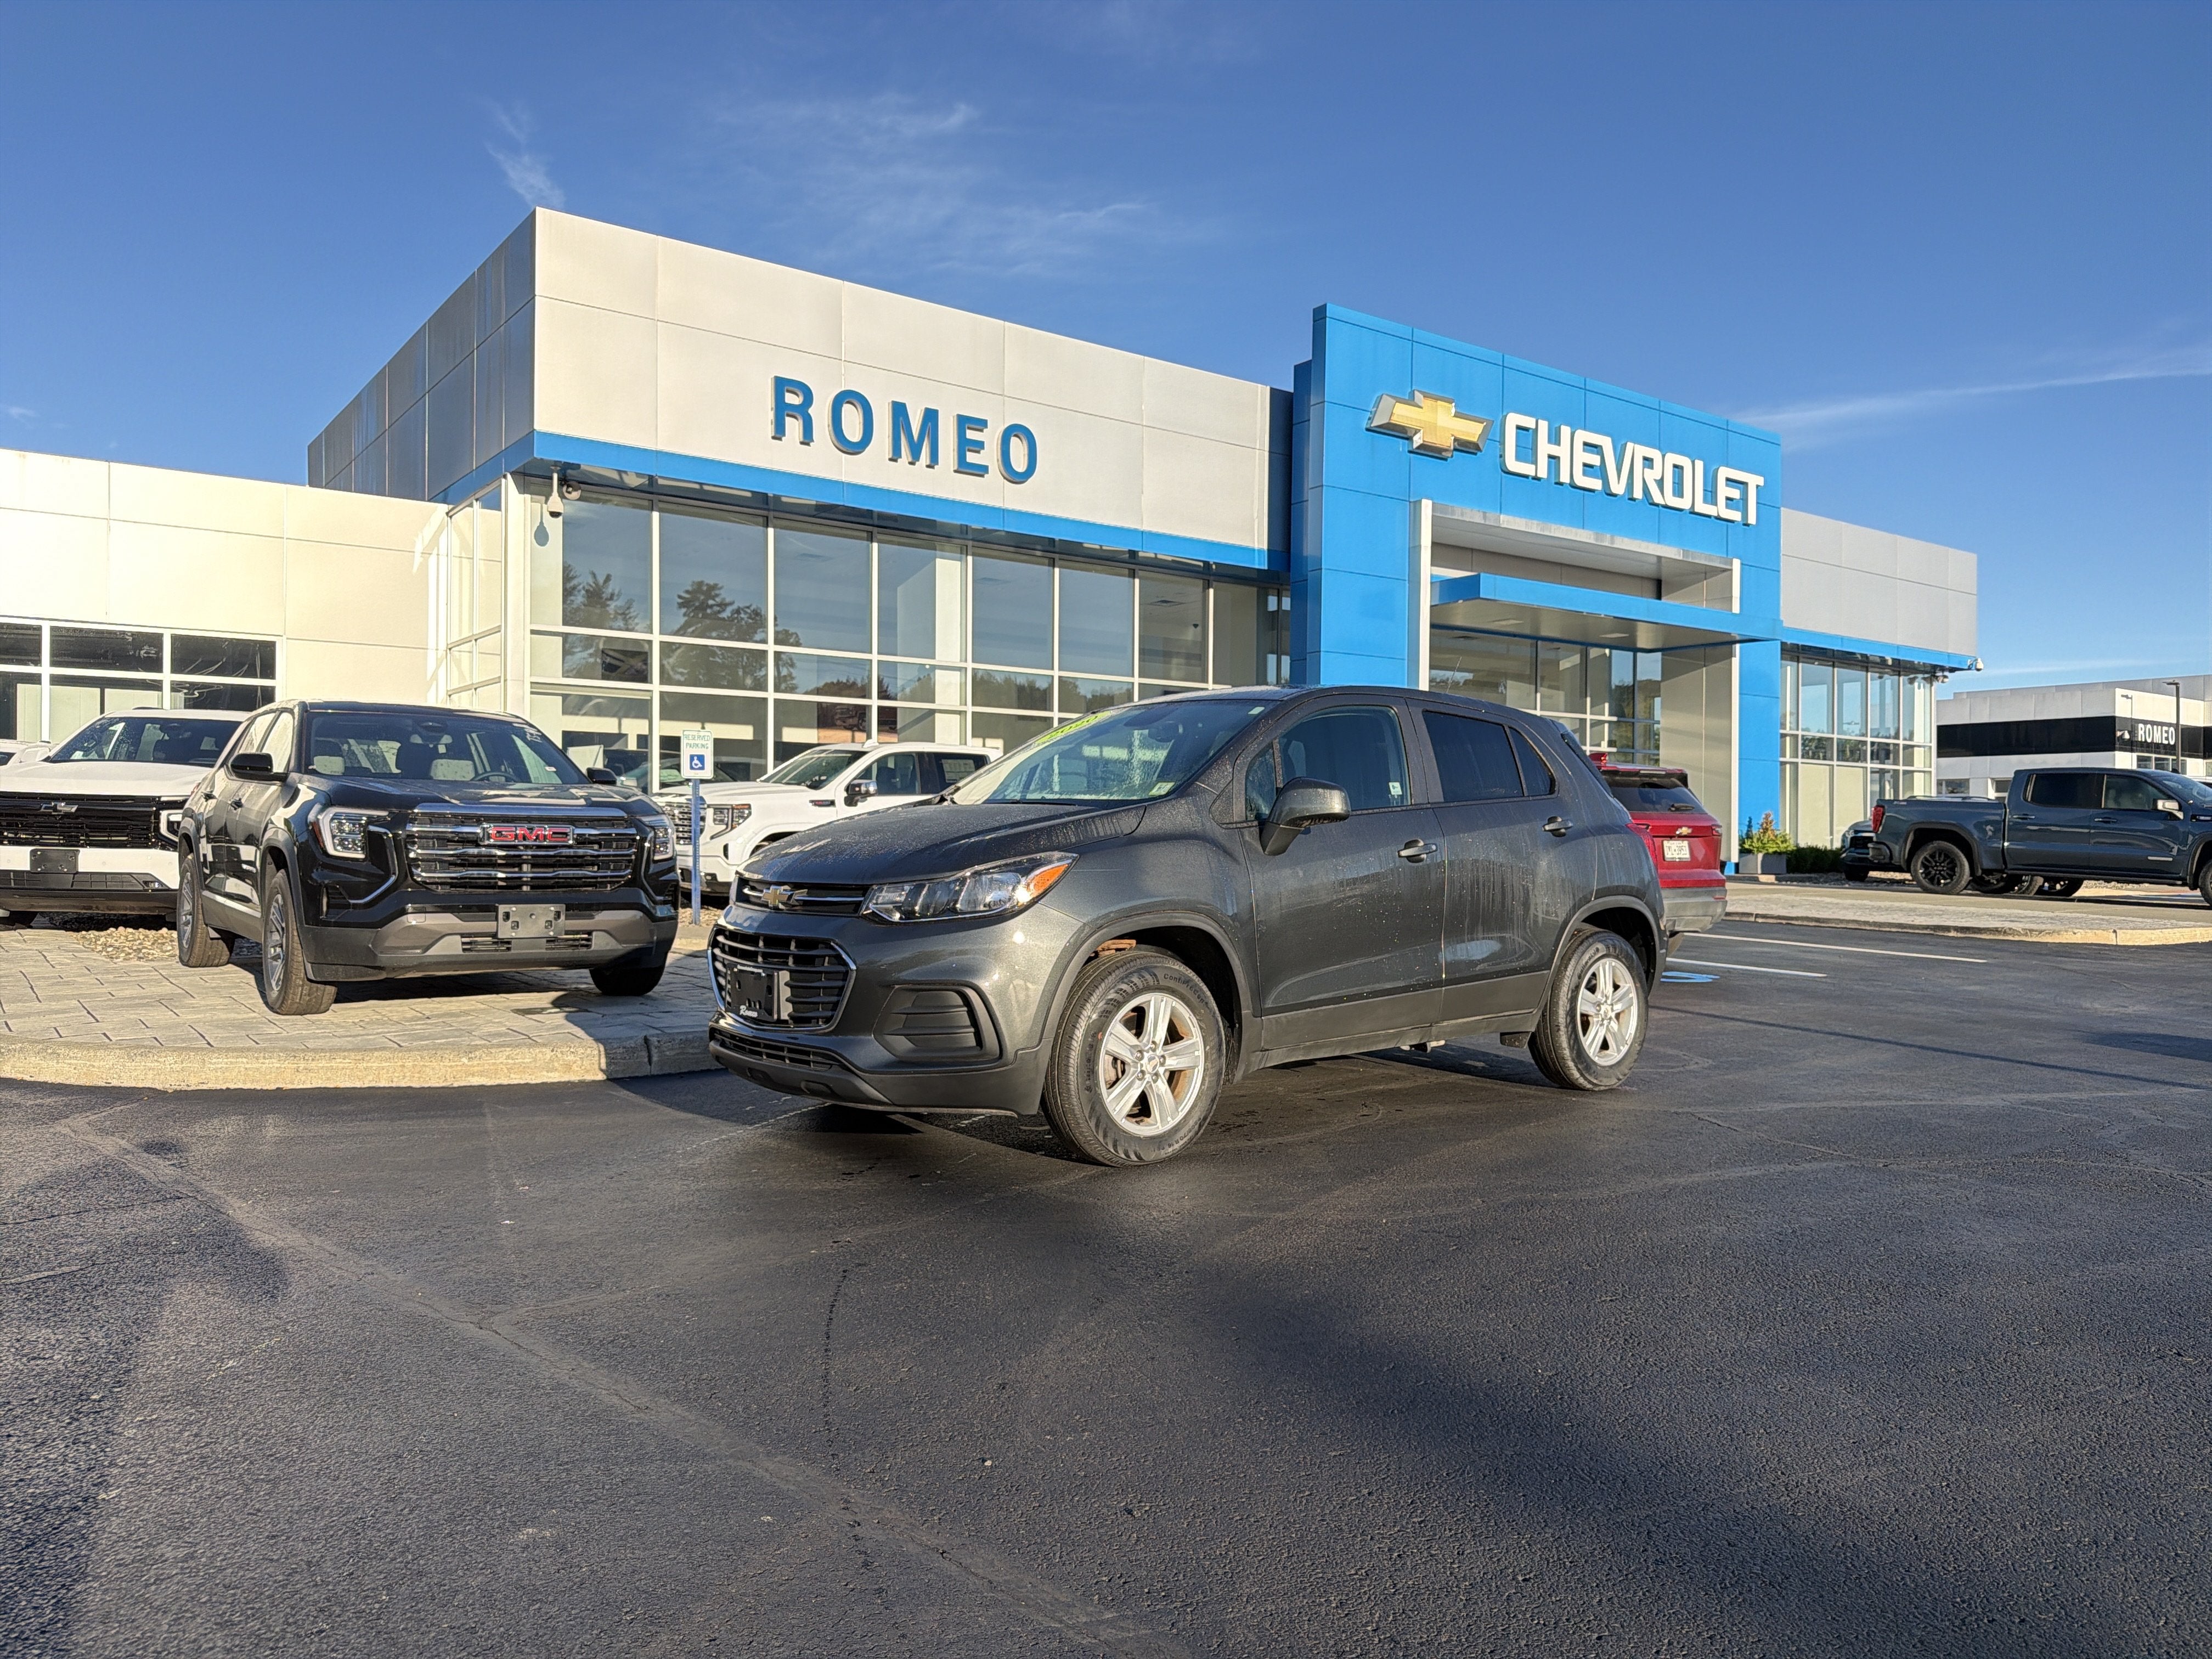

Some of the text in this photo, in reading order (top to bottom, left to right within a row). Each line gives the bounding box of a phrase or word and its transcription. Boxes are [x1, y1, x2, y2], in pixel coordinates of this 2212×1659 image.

[771, 375, 1037, 483] ROMEO
[1502, 412, 1764, 525] CHEVROLET
[684, 733, 711, 742] RESERVED
[2138, 723, 2175, 745] ROMEO
[490, 826, 571, 842] GMC
